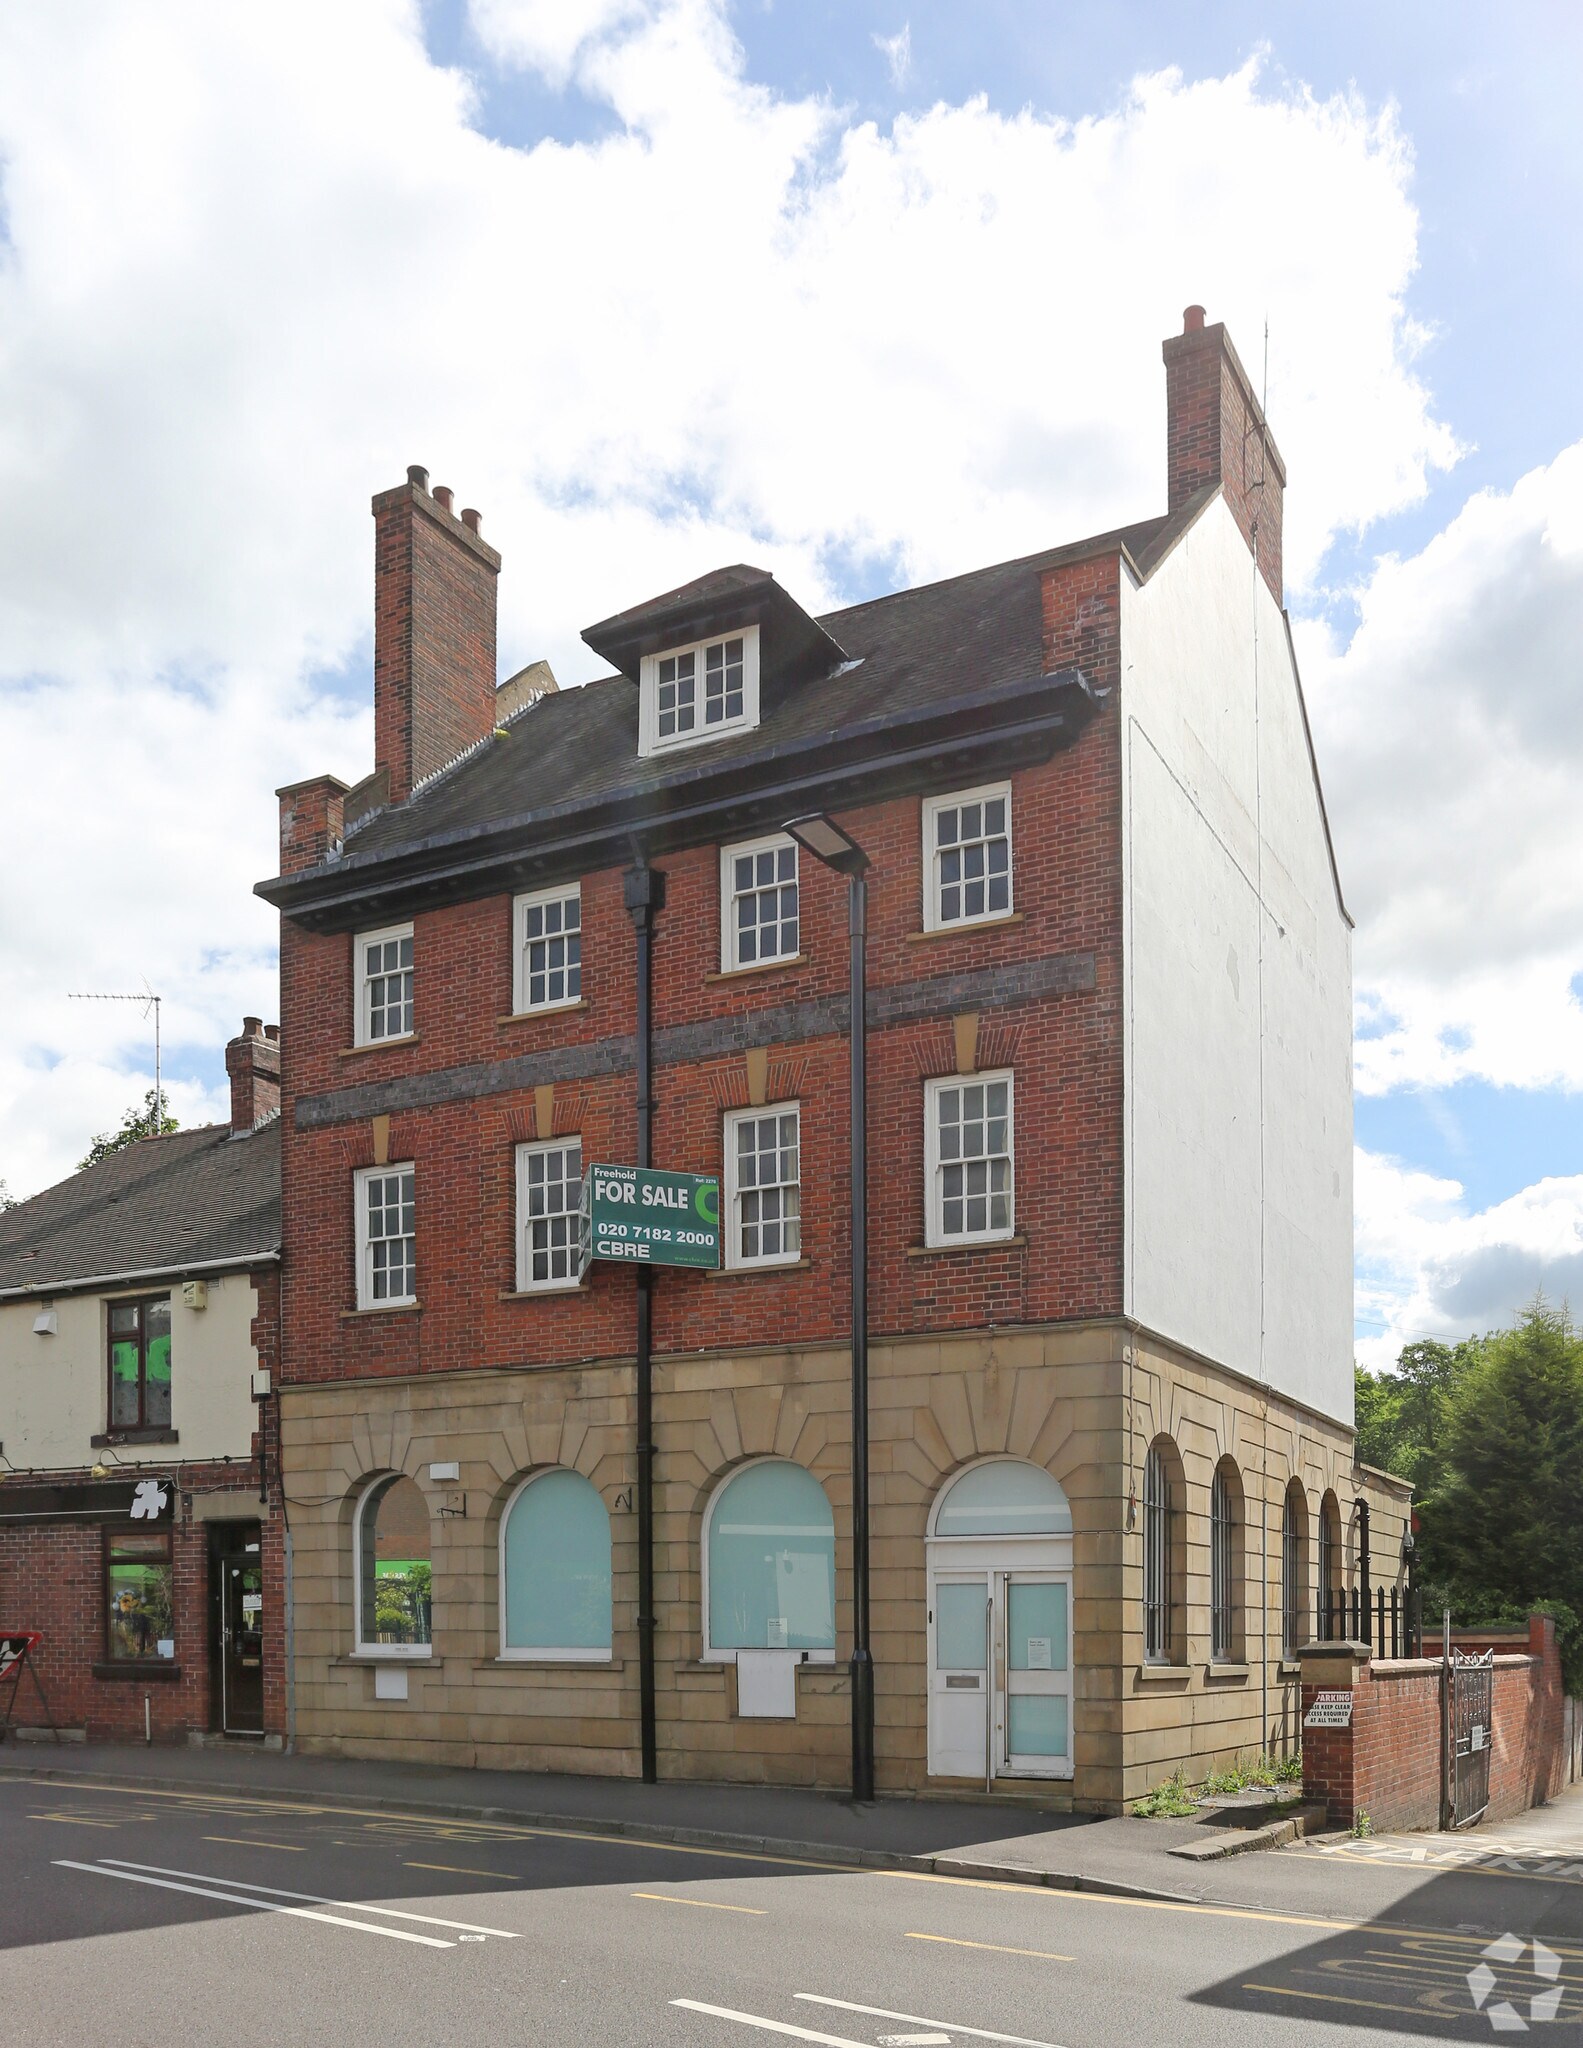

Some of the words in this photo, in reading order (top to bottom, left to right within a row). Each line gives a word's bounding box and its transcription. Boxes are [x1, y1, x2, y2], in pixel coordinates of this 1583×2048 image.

[594, 1168, 636, 1180] Freehold
[595, 1180, 636, 1204] FOR
[642, 1185, 689, 1209] SALE
[598, 1223, 628, 1237] 020
[633, 1226, 672, 1241] 7182
[676, 1231, 715, 1246] 2000
[597, 1241, 650, 1258] CBRE
[1316, 1694, 1350, 1702] PARKING
